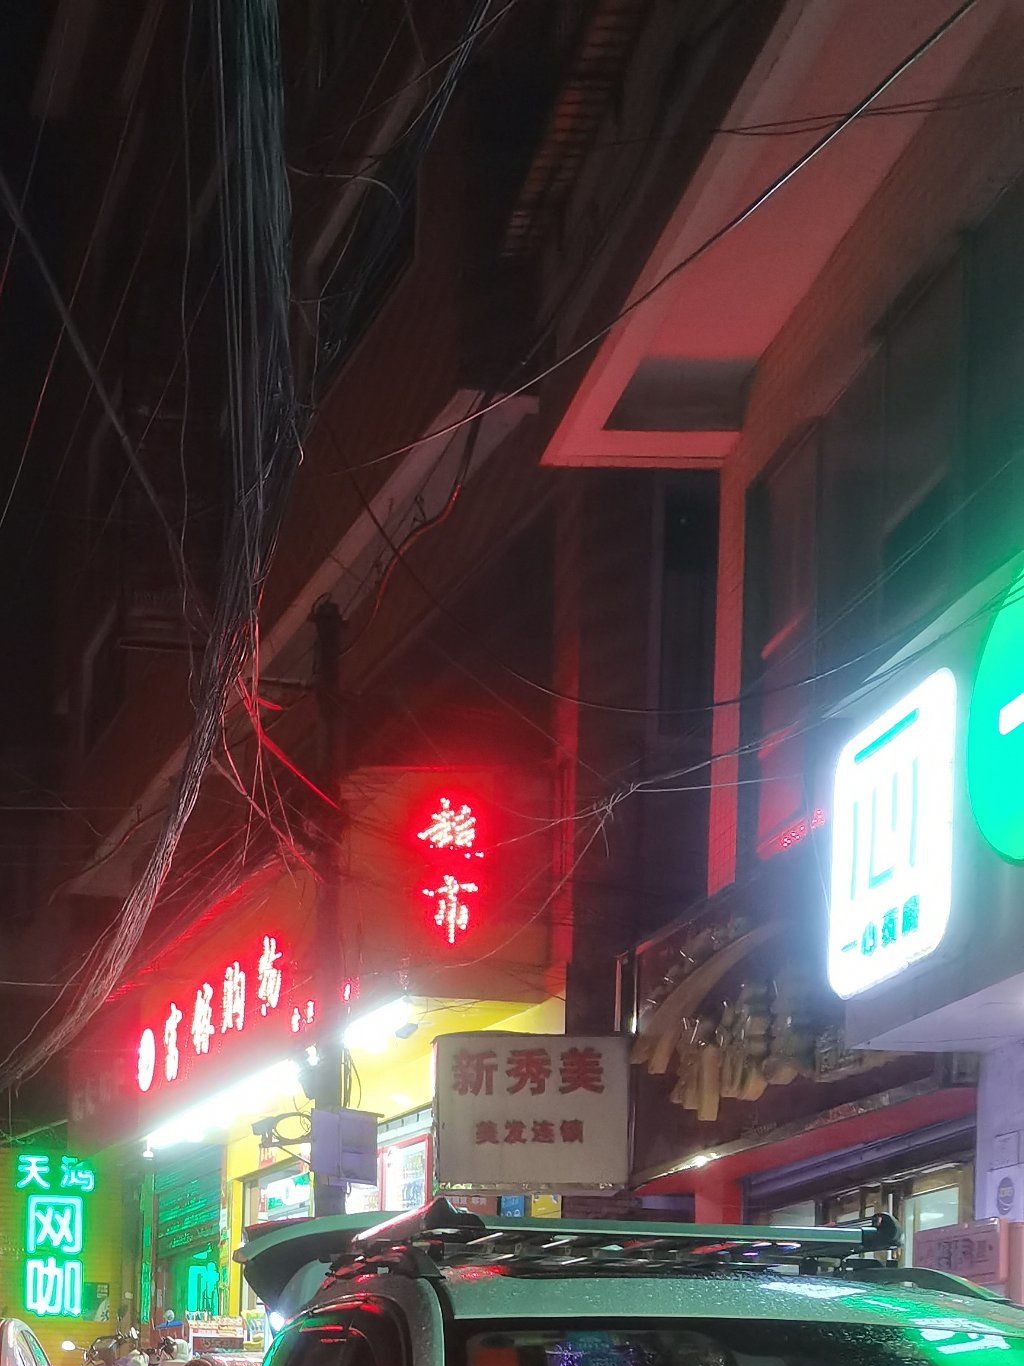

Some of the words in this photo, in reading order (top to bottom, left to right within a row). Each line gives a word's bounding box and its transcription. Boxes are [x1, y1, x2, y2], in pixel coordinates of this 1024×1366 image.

[452, 1048, 605, 1096] 新秀美
[475, 1119, 584, 1145] 美发连锁
[26, 1195, 84, 1317] 网咖
